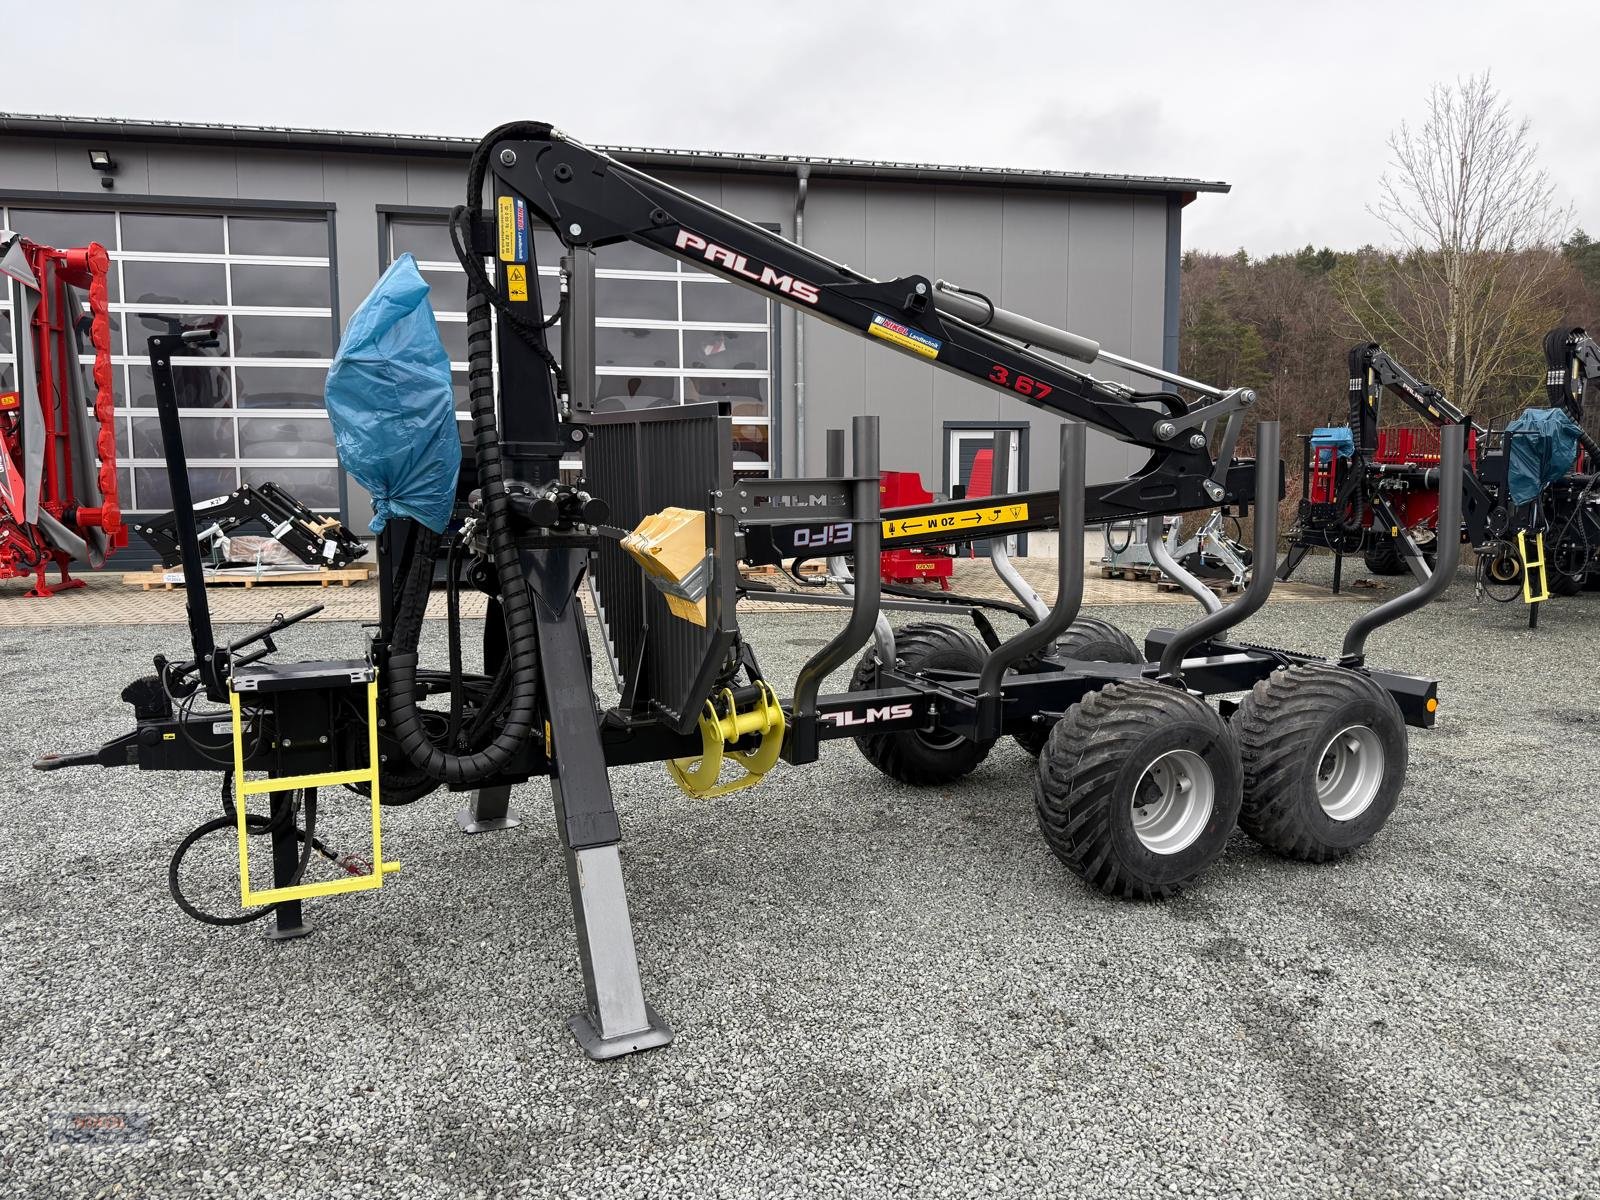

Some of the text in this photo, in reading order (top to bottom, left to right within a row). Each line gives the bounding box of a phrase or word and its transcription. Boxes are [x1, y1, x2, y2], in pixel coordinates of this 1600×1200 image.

[675, 229, 821, 304] PALMS
[882, 319, 909, 336] NIKOL
[909, 332, 939, 349] Landtechnik
[928, 517, 955, 529] 20 M
[820, 703, 913, 727] ALMS
